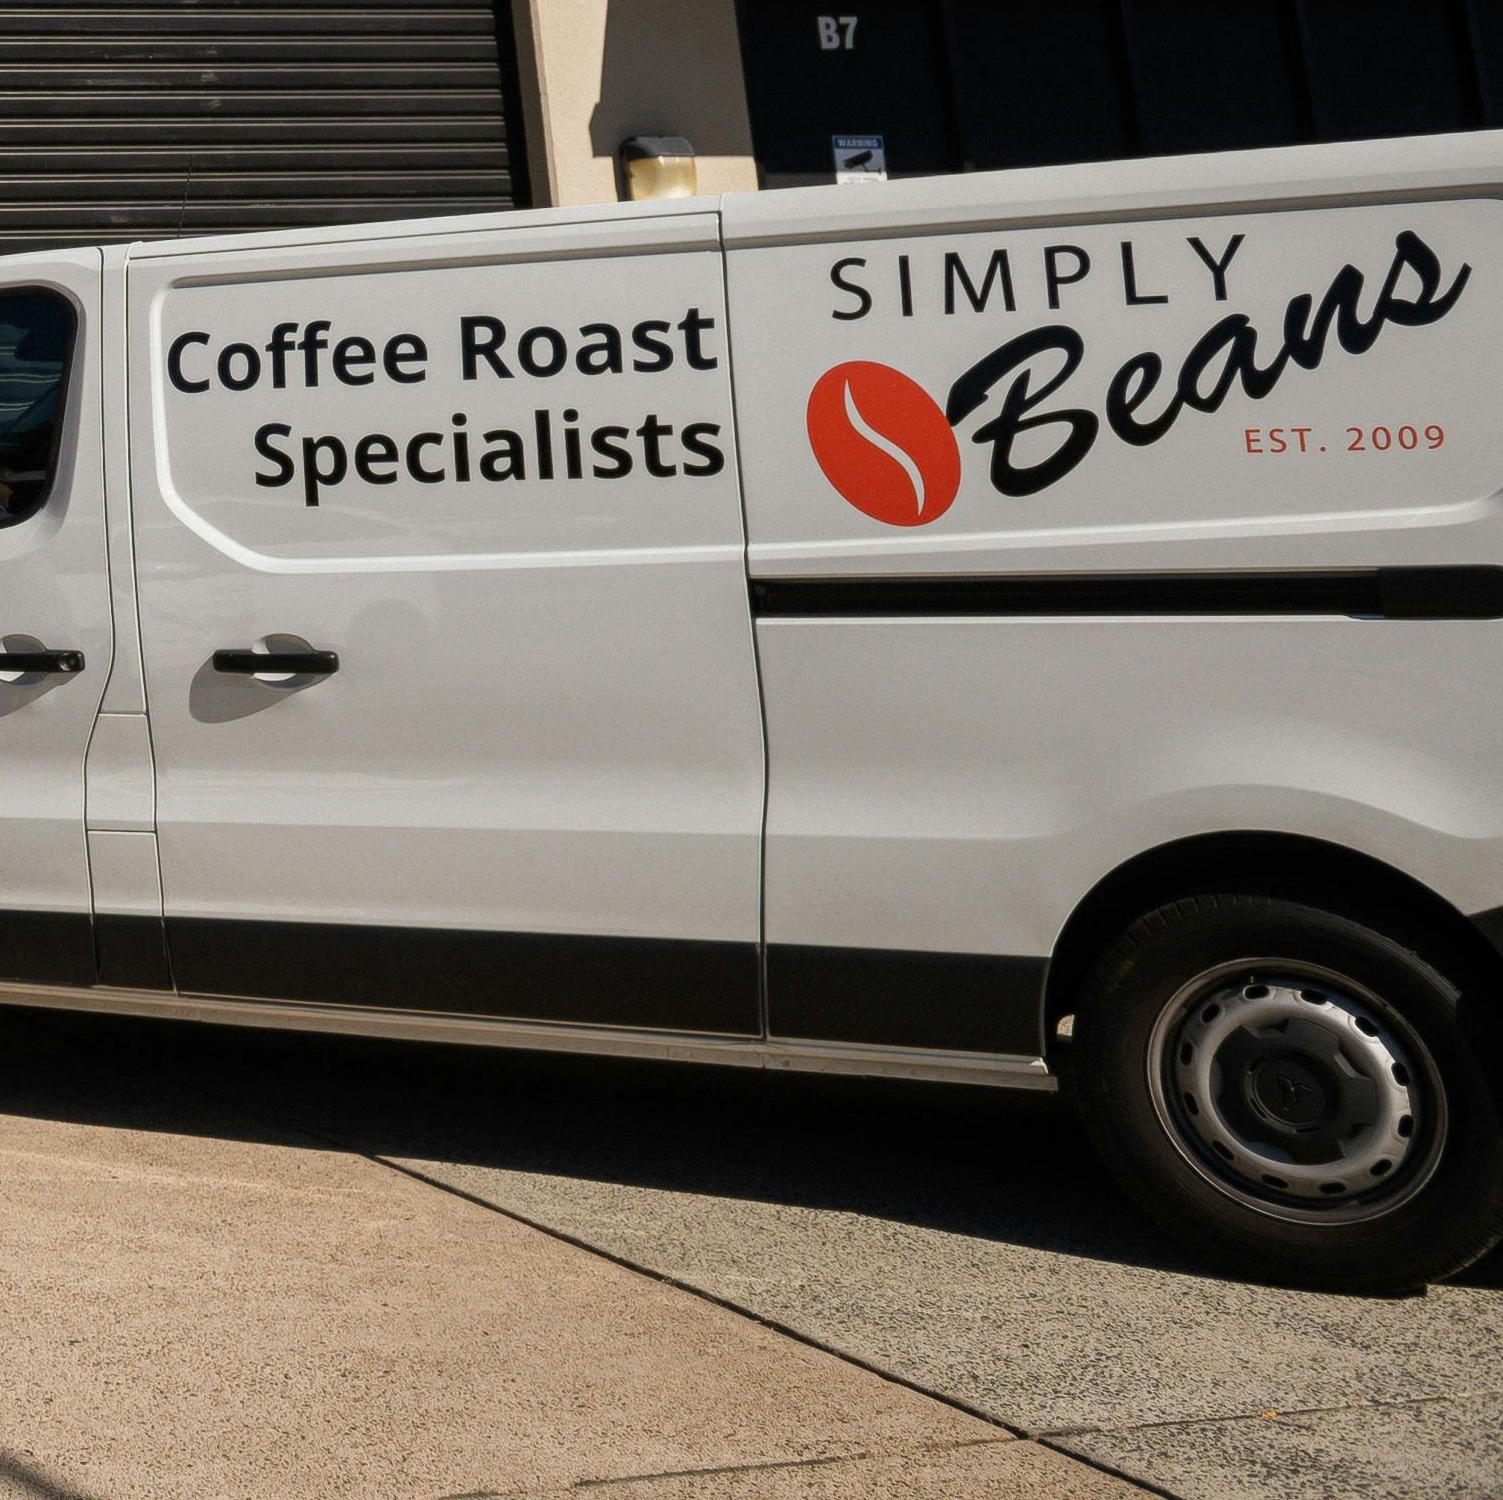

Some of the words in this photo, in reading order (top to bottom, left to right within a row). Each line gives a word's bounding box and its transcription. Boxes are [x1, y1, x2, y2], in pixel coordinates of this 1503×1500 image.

[817, 16, 858, 51] B7
[829, 233, 1247, 322] SIMPLY
[166, 320, 429, 395] Coffee
[459, 306, 719, 382] Roast
[945, 229, 1473, 499] Beans
[253, 406, 726, 508] Specialists
[1244, 427, 1328, 454] EST.
[1346, 424, 1447, 452] 2009
